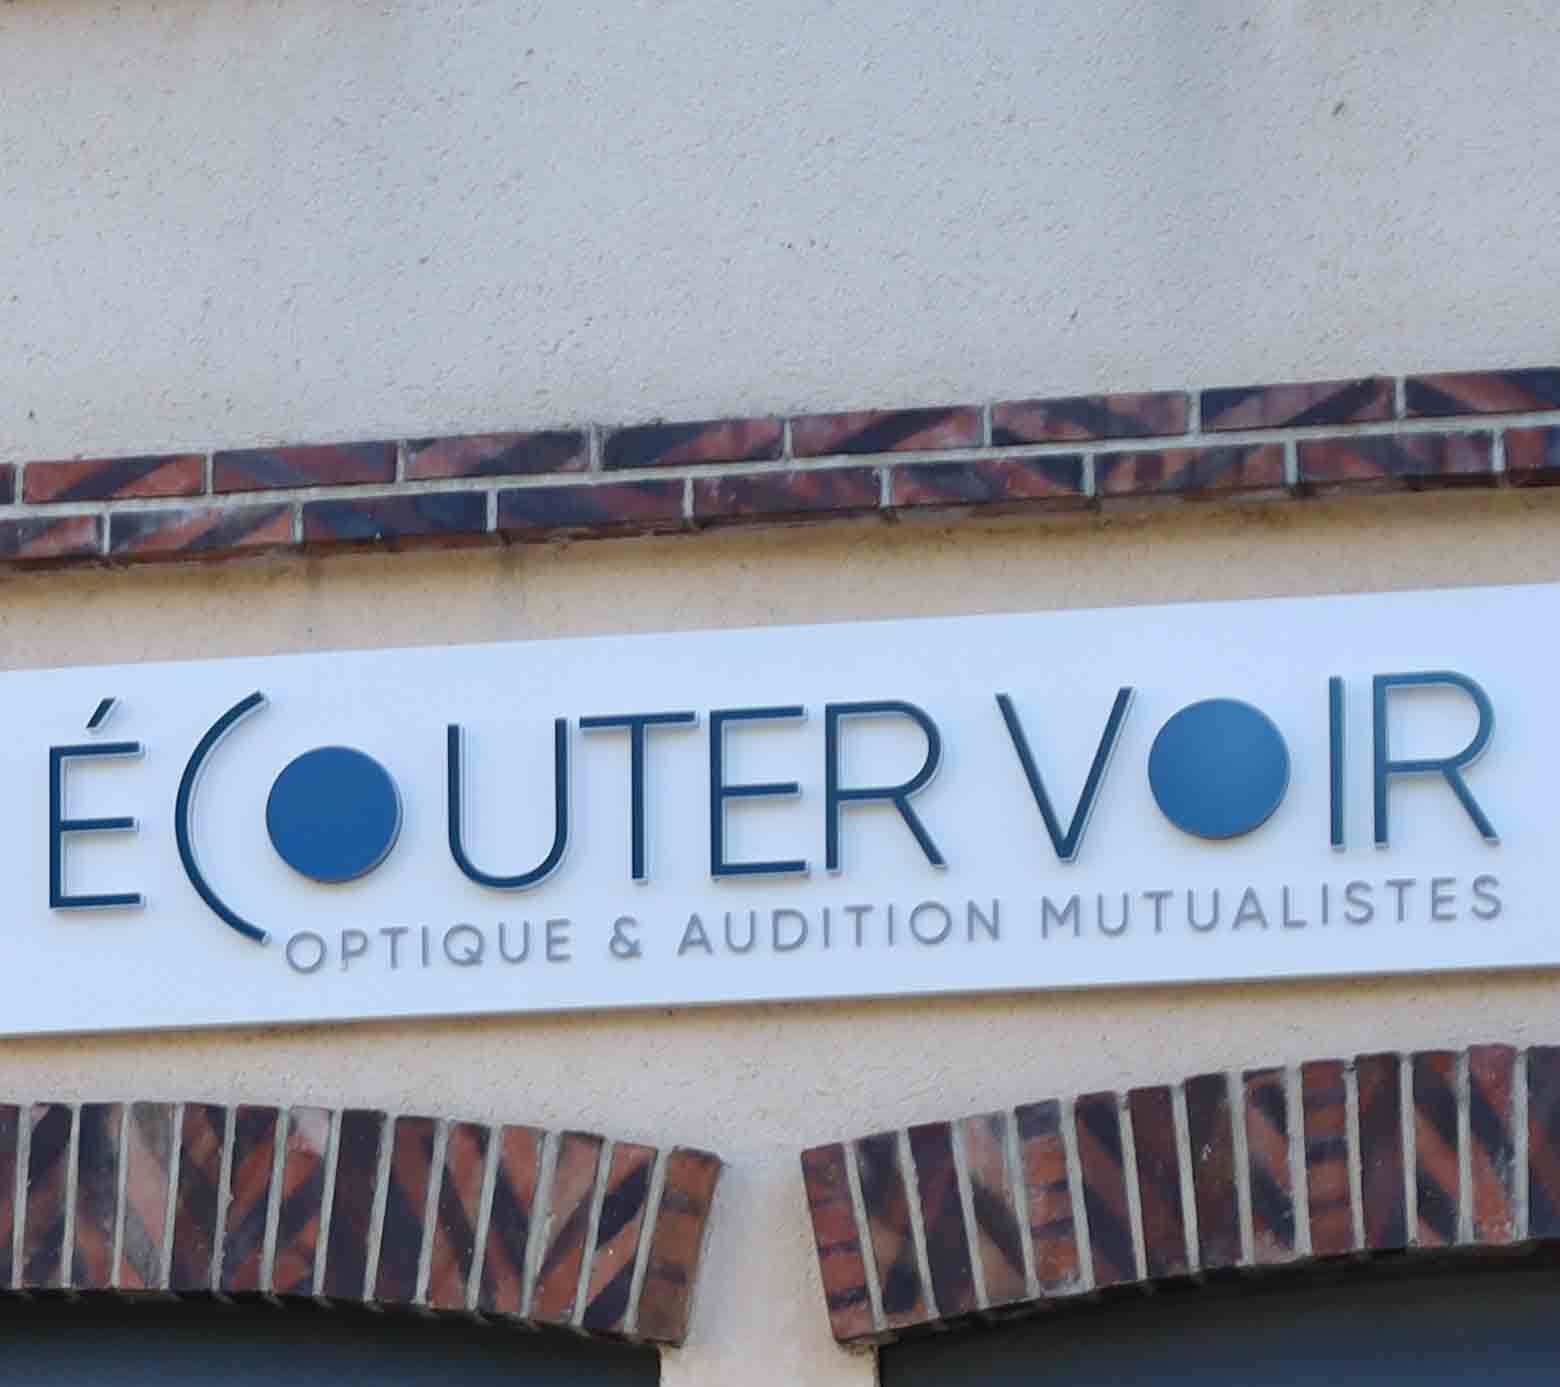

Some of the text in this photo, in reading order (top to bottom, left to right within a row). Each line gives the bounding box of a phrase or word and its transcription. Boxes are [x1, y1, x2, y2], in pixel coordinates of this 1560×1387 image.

[48, 670, 1500, 943] ÉCOUTER VOIR
[284, 875, 1506, 977] OPTIQUE & AUDITION MUTUALISTES
